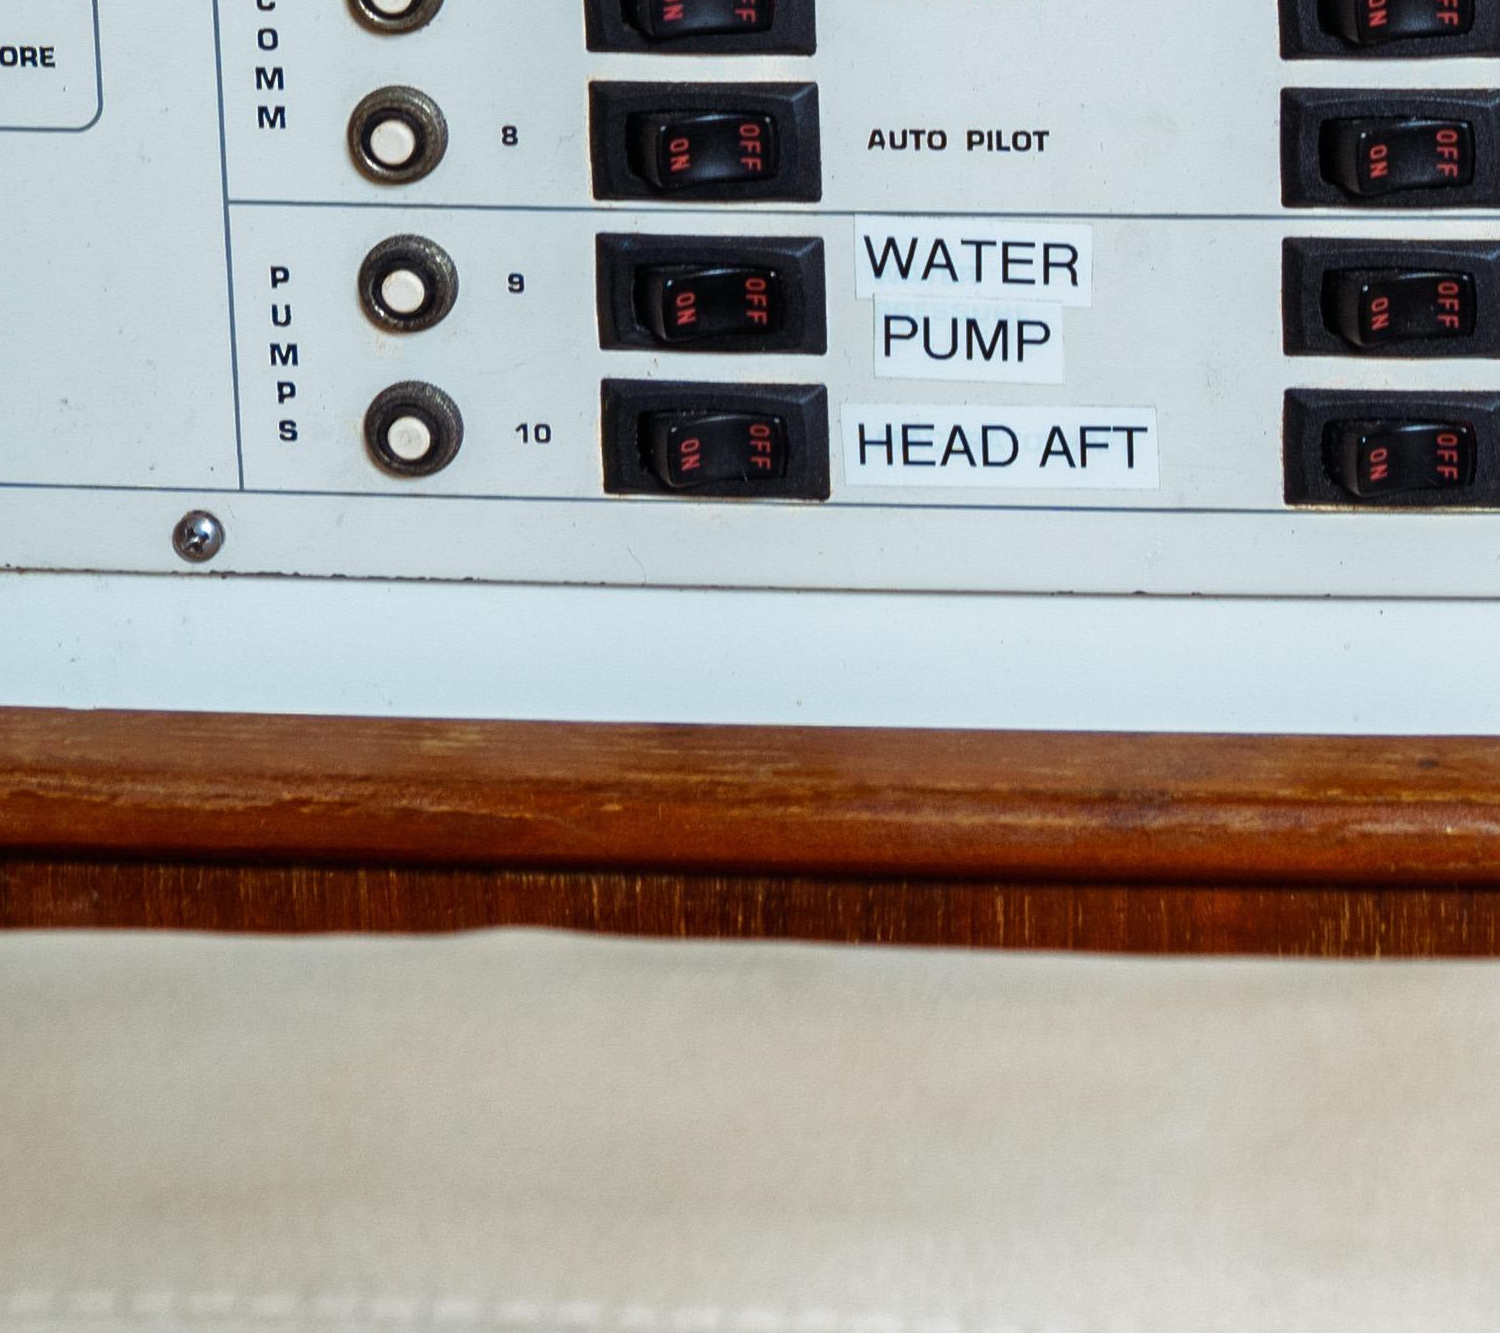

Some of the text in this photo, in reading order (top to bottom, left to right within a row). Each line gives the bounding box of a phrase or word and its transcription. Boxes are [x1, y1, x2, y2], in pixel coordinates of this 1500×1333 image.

[867, 128, 1050, 152] AUTO PILOT
[863, 235, 1079, 287] WATER
[269, 265, 299, 442] PUMPS
[883, 314, 1051, 362] PUMP
[858, 423, 1148, 469] HEAD AFT
